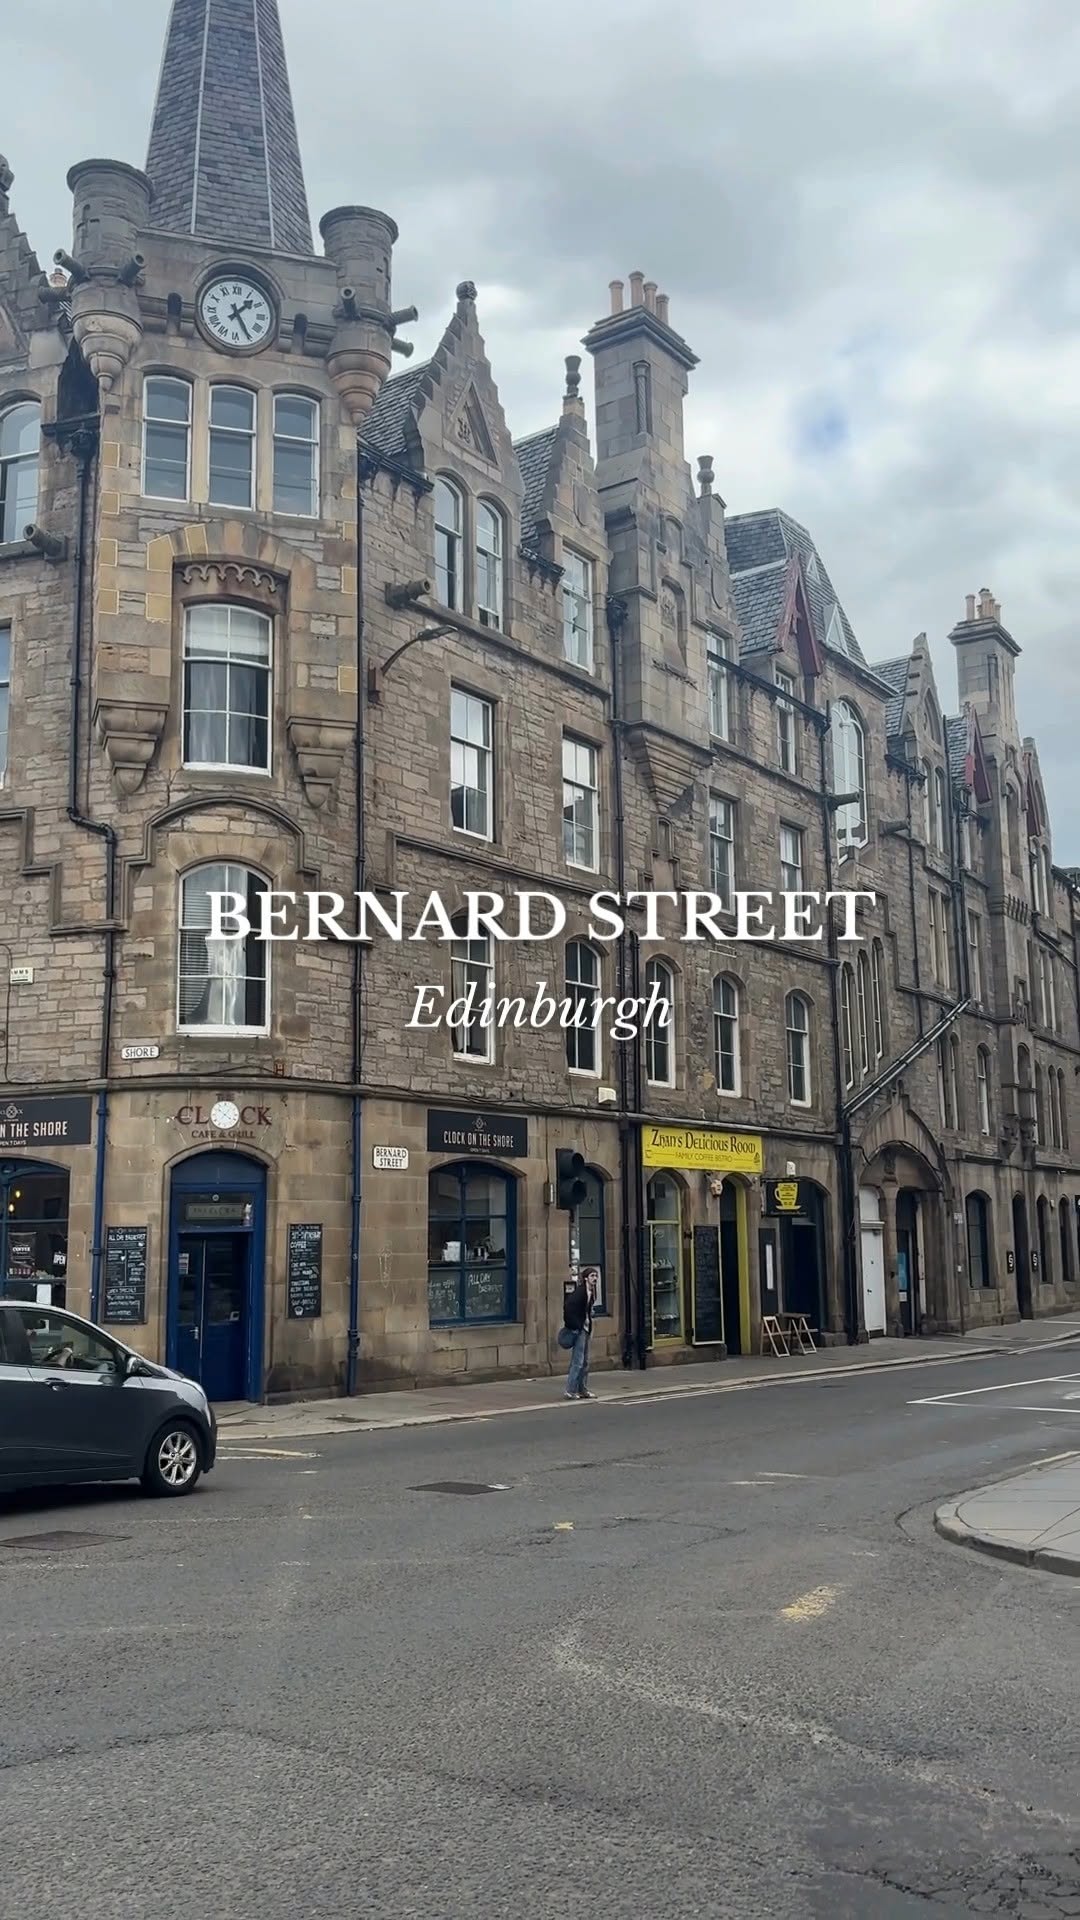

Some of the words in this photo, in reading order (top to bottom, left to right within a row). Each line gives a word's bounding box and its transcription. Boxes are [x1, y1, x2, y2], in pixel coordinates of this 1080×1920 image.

[220, 286, 230, 297] XI
[233, 286, 242, 295] XII
[211, 295, 220, 303] X
[125, 1047, 155, 1058] SHORE
[10, 1123, 29, 1138] THE
[33, 1121, 68, 1137] SHORE
[228, 1130, 256, 1139] GRILL
[443, 1131, 466, 1144] CLOCK
[467, 1132, 477, 1145] ON
[479, 1133, 491, 1147] THE
[493, 1134, 514, 1148] SHORE
[376, 1147, 407, 1159] BERNARD
[675, 1151, 694, 1160] FAMILY
[694, 1153, 714, 1161] COFFEE
[715, 1154, 733, 1162] BISTRO
[380, 1157, 404, 1168] STREET
